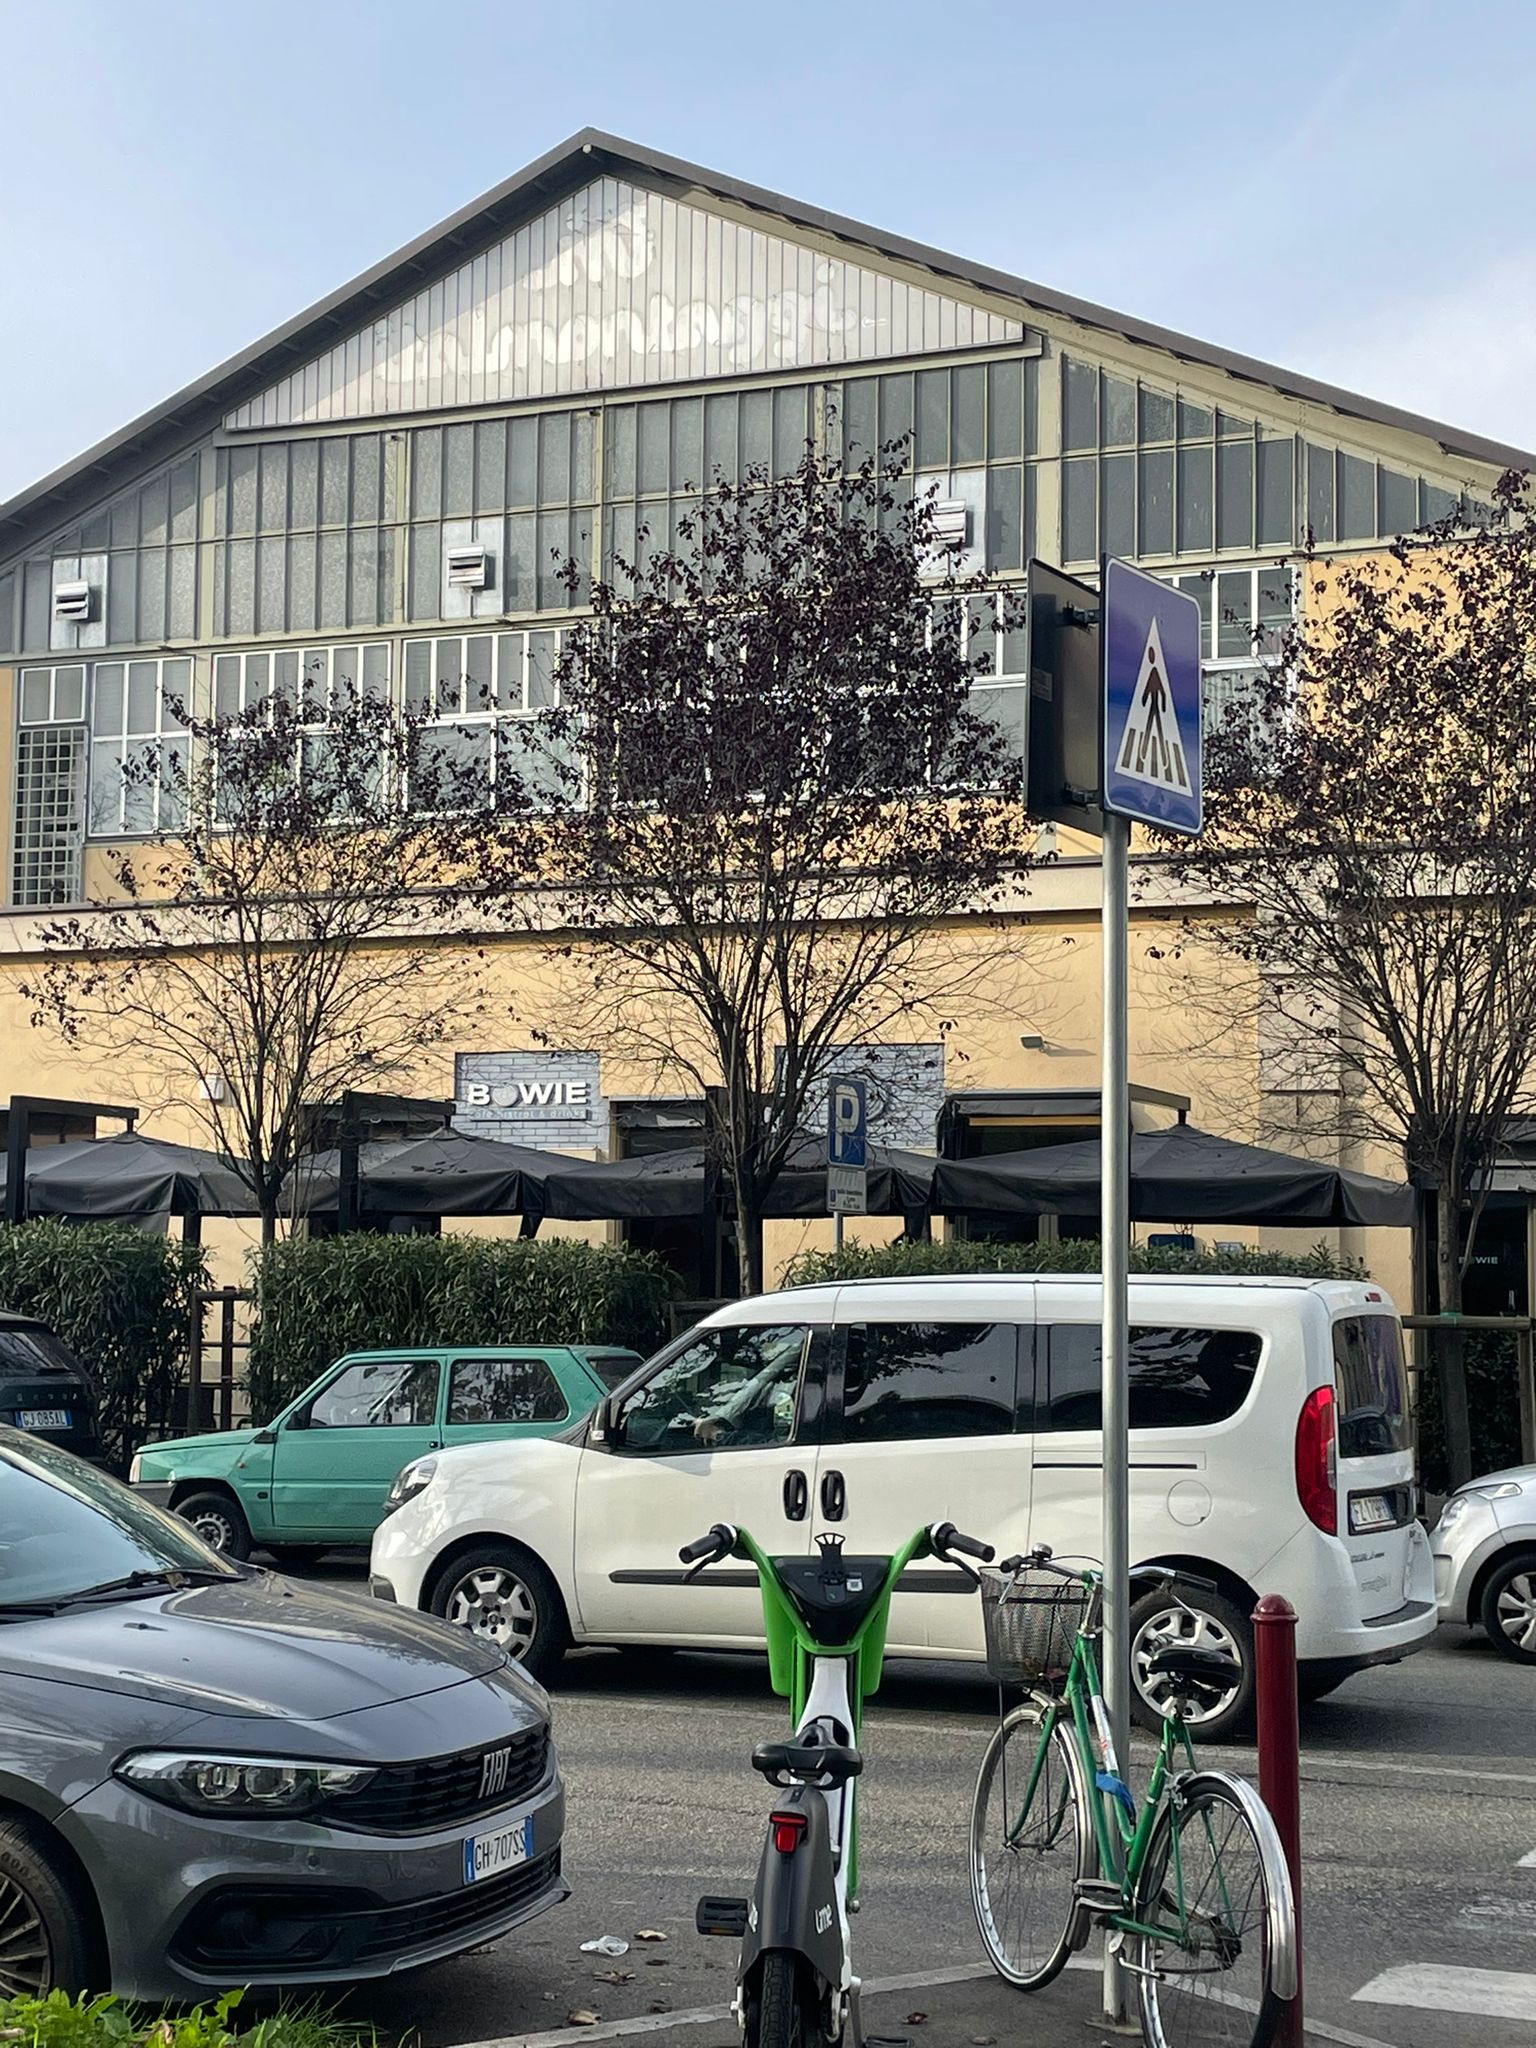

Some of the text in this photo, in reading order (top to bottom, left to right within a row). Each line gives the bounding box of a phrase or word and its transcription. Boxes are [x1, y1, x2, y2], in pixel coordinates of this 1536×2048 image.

[468, 1081, 587, 1107] BOWIE
[834, 1084, 860, 1158] P
[478, 1747, 512, 1799] FIAT
